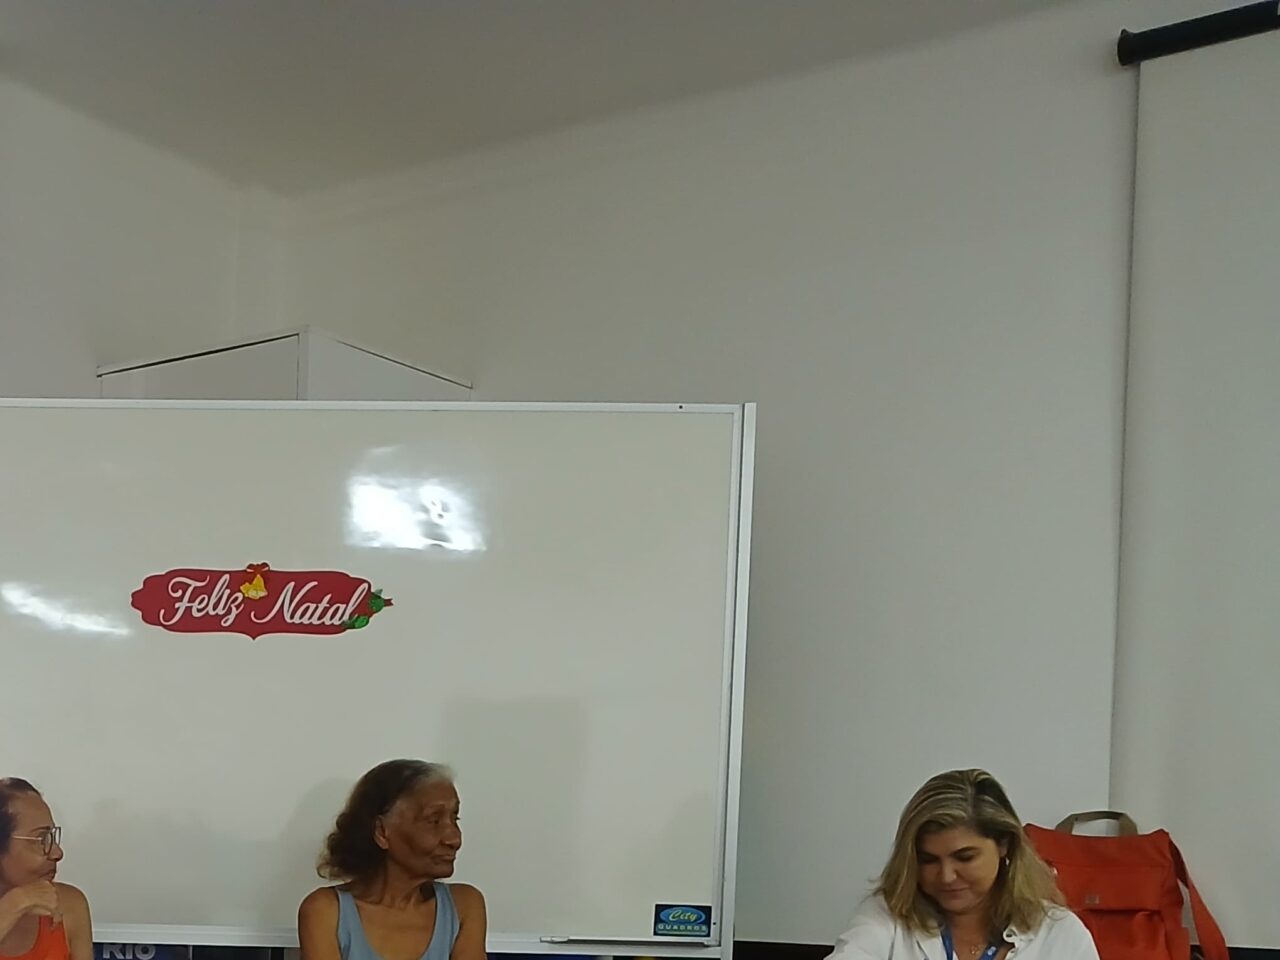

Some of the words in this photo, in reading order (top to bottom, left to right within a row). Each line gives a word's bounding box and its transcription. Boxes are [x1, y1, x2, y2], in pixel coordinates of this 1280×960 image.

[159, 573, 245, 627] Feliz
[250, 581, 370, 626] Natal
[669, 910, 697, 922] City
[658, 923, 707, 931] QUADROS
[102, 943, 156, 960] RIO
